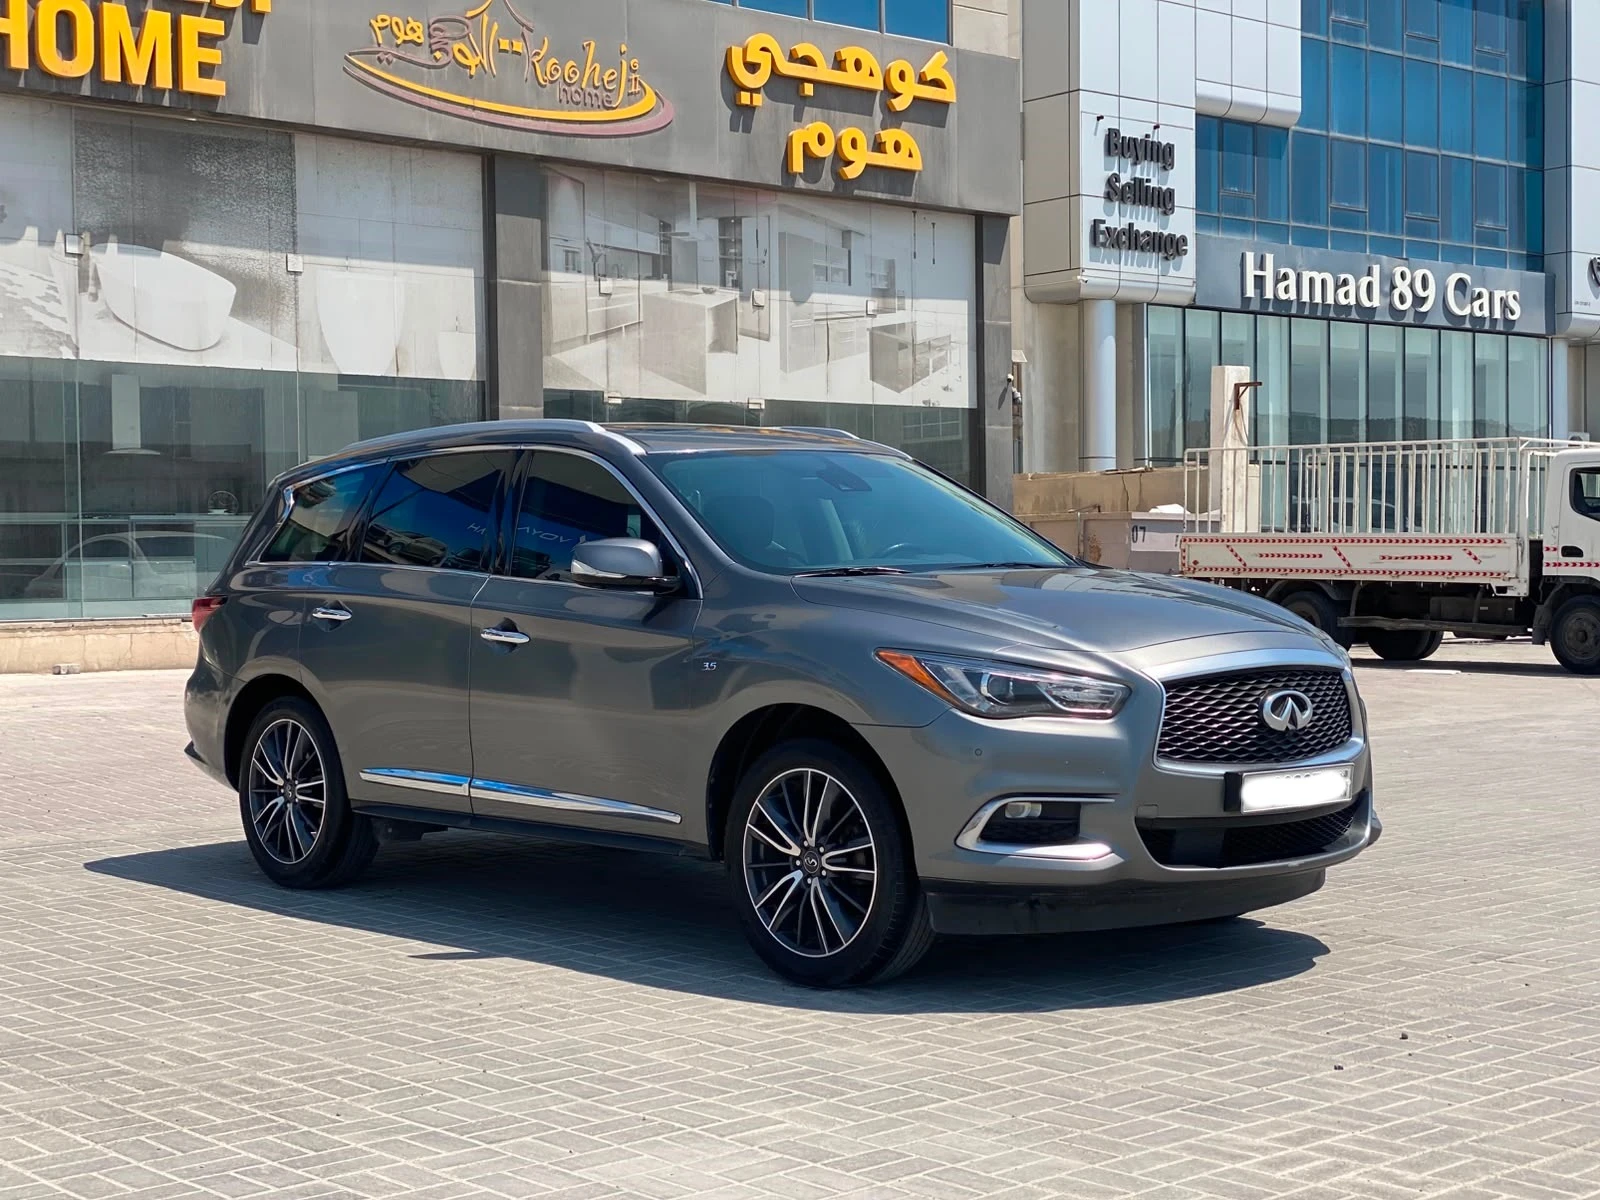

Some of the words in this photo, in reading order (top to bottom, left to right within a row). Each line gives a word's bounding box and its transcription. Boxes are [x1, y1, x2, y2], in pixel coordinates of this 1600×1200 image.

[726, 33, 957, 112] كوهجي
[787, 121, 923, 180] هوم
[1106, 127, 1175, 171] Buying
[1106, 172, 1175, 215] Selling
[1092, 218, 1188, 260] Exchange
[1242, 251, 1381, 308] Hamad
[1390, 266, 1437, 313] 89
[1444, 272, 1521, 321] Cars
